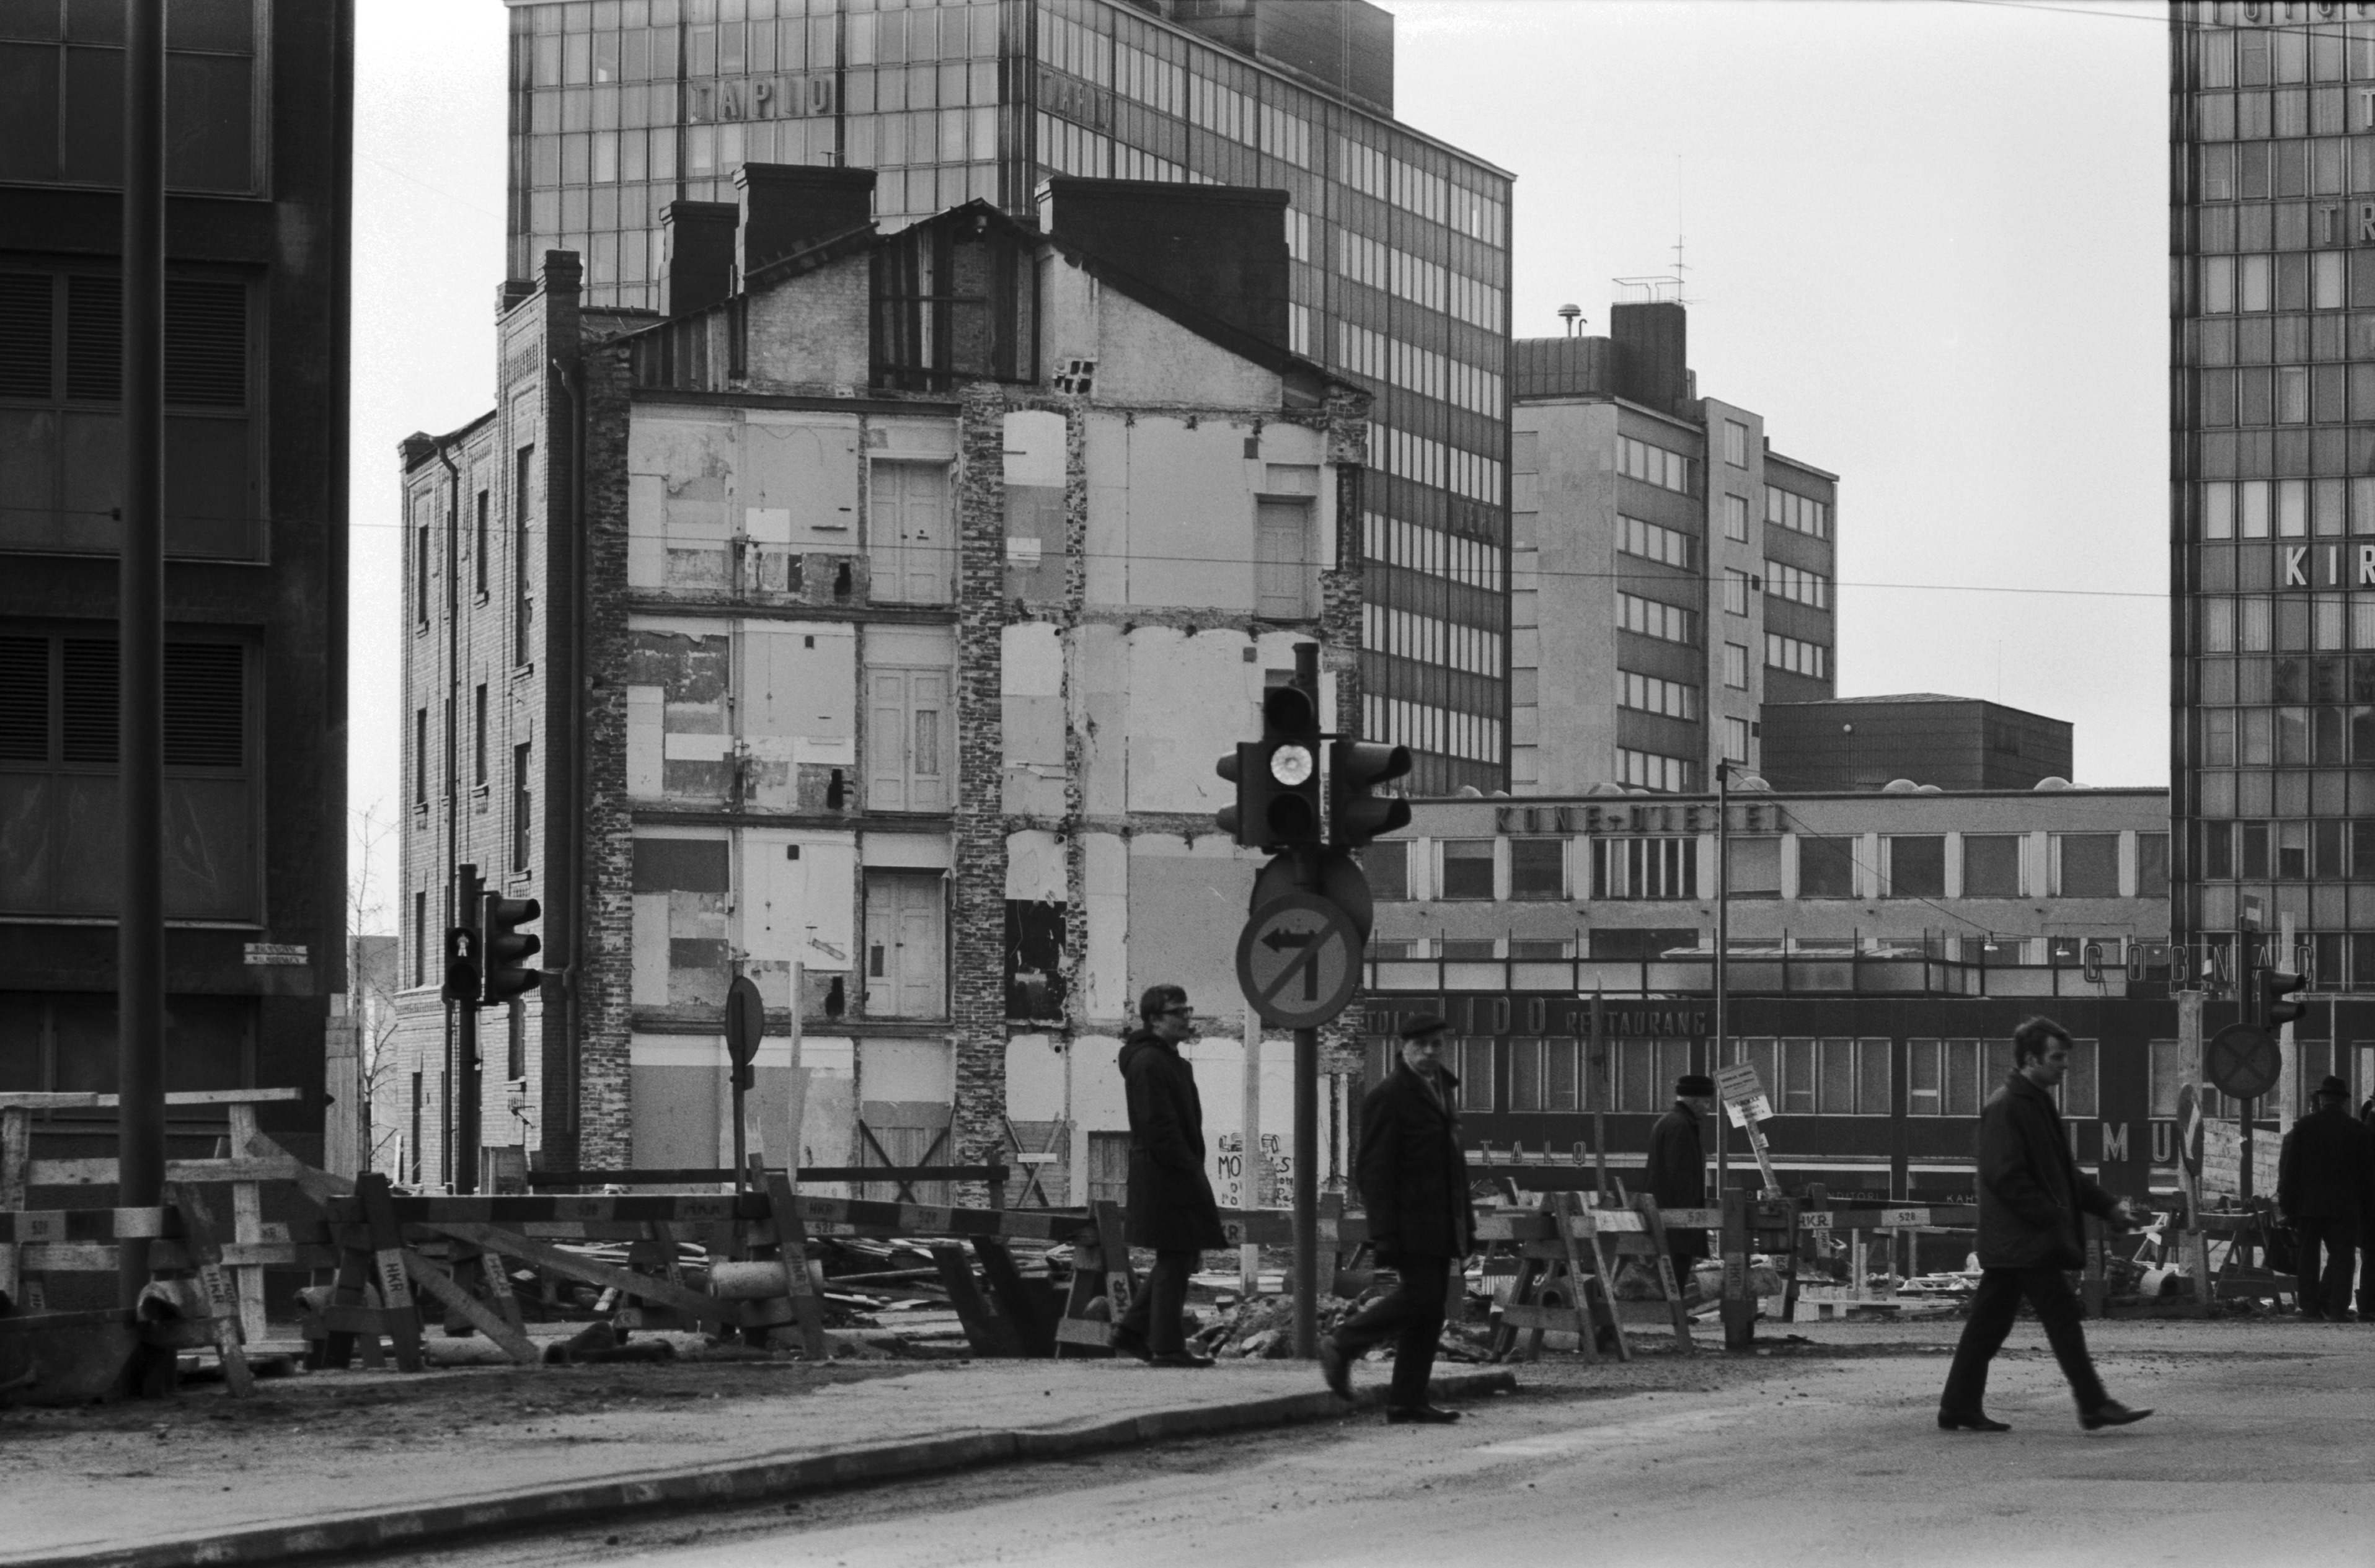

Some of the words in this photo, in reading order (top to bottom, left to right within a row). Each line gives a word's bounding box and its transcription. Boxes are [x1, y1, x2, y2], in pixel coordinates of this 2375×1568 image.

[691, 76, 831, 120] TAPIO
[2320, 203, 2375, 243] TR
[2286, 545, 2375, 585] KIR
[2084, 944, 2313, 983] COGNAC
[1439, 996, 1545, 1034] LIDO
[1567, 1011, 1705, 1034] RETAURANG
[1826, 1191, 1880, 1200] NDITORI
[1947, 1194, 1979, 1204] KAH
[1898, 1212, 1916, 1222] 528
[207, 1271, 225, 1304] HKR
[385, 1262, 404, 1292] HKR
